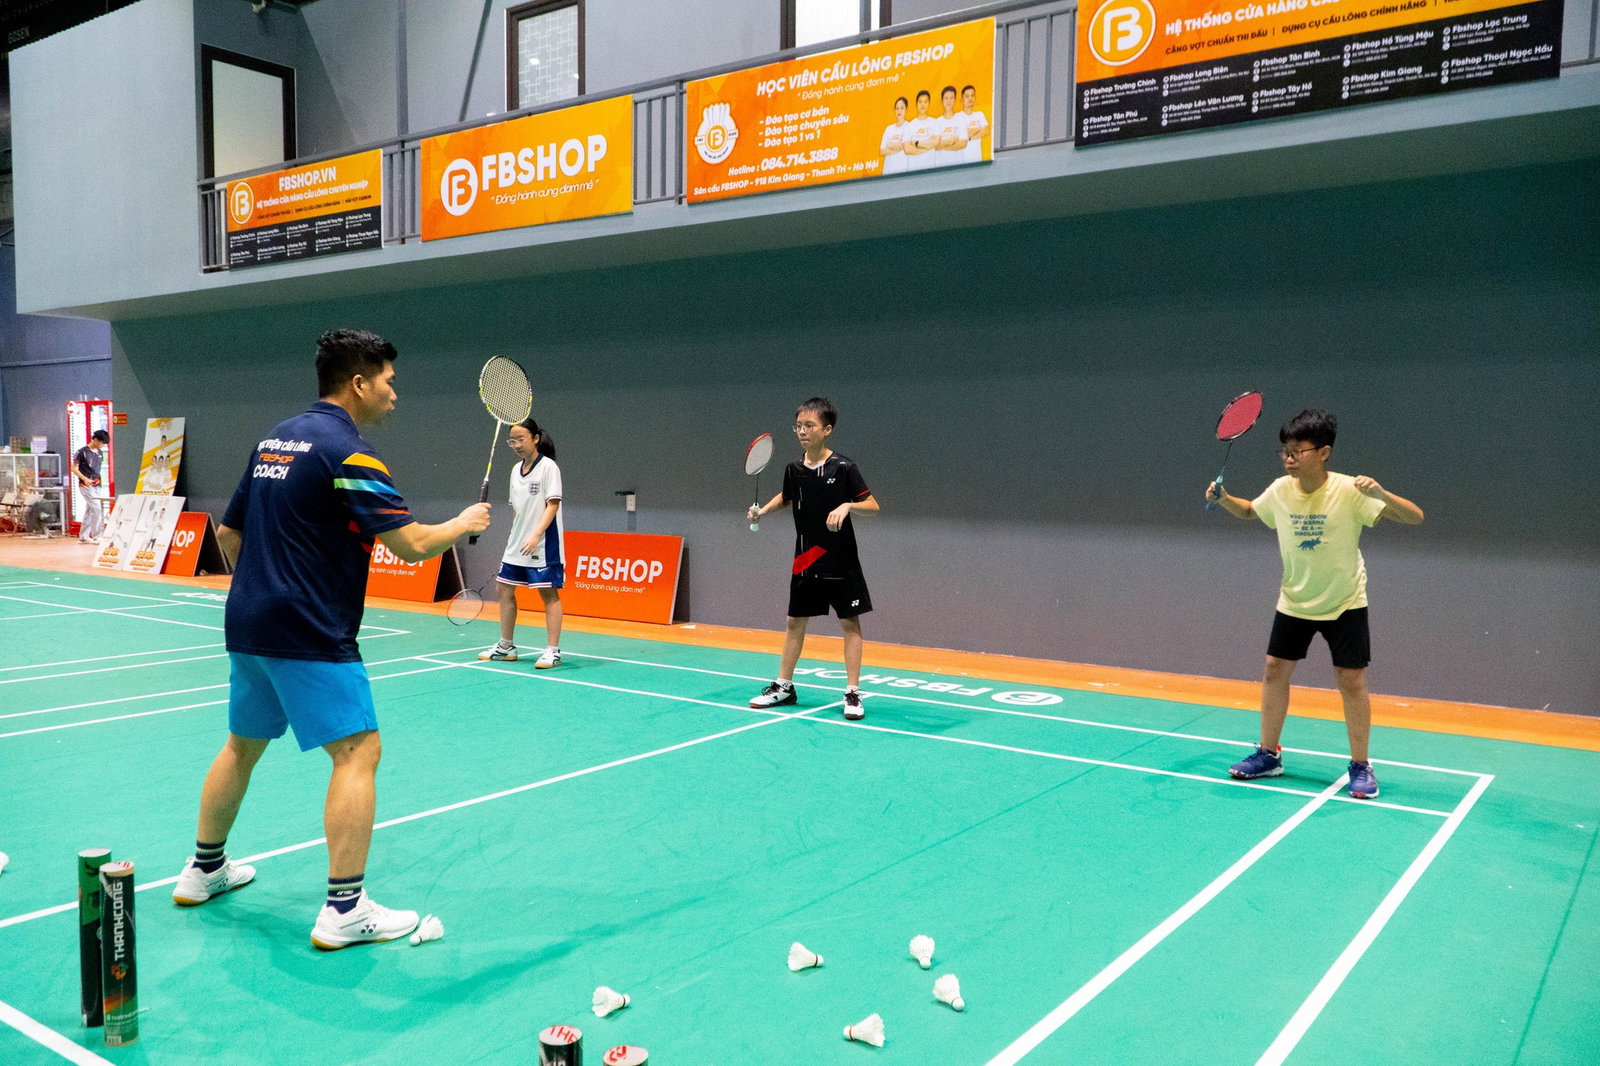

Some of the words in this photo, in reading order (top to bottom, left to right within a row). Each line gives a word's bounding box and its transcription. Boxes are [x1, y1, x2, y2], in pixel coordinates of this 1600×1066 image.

[1166, 19, 1182, 37] HỆ
[1184, 11, 1232, 31] THỐNG
[1236, 33, 1249, 41] THI
[1250, 28, 1268, 39] ĐẤU
[1308, 20, 1321, 29] CỤ
[1322, 14, 1341, 25] CẦU
[1343, 12, 1368, 22] LÔNG
[1370, 7, 1398, 17] CHÍNH
[1452, 23, 1483, 34] Fbshop
[1503, 14, 1527, 26] Trung
[1352, 40, 1380, 50] Fbshop
[1262, 57, 1287, 66] Fbshop
[1451, 56, 1481, 67] Fbshop
[757, 78, 786, 98] HỌC
[821, 61, 850, 82] CẦU
[852, 56, 892, 77] LÔNG
[895, 43, 954, 68] FBSHOP
[1350, 73, 1379, 83] Fbshop
[1380, 70, 1396, 78] Kim
[1397, 66, 1422, 76] Giang
[866, 77, 884, 87] đam
[1170, 73, 1193, 82] Fbshop
[1090, 86, 1113, 95] Fbshop
[1260, 88, 1286, 97] Fbshop
[1169, 102, 1192, 112] Fbshop
[765, 126, 782, 136] Đào
[784, 124, 798, 135] tạo
[800, 117, 831, 130] chuyên
[833, 114, 849, 124] sâu
[766, 115, 782, 125] Đào
[784, 113, 798, 124] tạo
[1090, 115, 1112, 123] Fbshop
[764, 137, 781, 148] Đào
[783, 135, 797, 146] tạo
[482, 134, 607, 191] FBSHOP
[721, 180, 748, 191] FBSHOP
[767, 175, 782, 184] Kim
[783, 172, 804, 182] Giang
[811, 167, 835, 177] Thanh
[853, 162, 864, 172] Hà
[866, 160, 879, 171] Nội
[728, 166, 755, 176] Hotline
[279, 167, 336, 192] FBSHOP.VN
[560, 184, 579, 194] đam
[259, 453, 294, 463] FBSHOP
[253, 464, 289, 479] COACH
[576, 556, 663, 583] FBSHOP
[113, 881, 124, 962] THANHCONG
